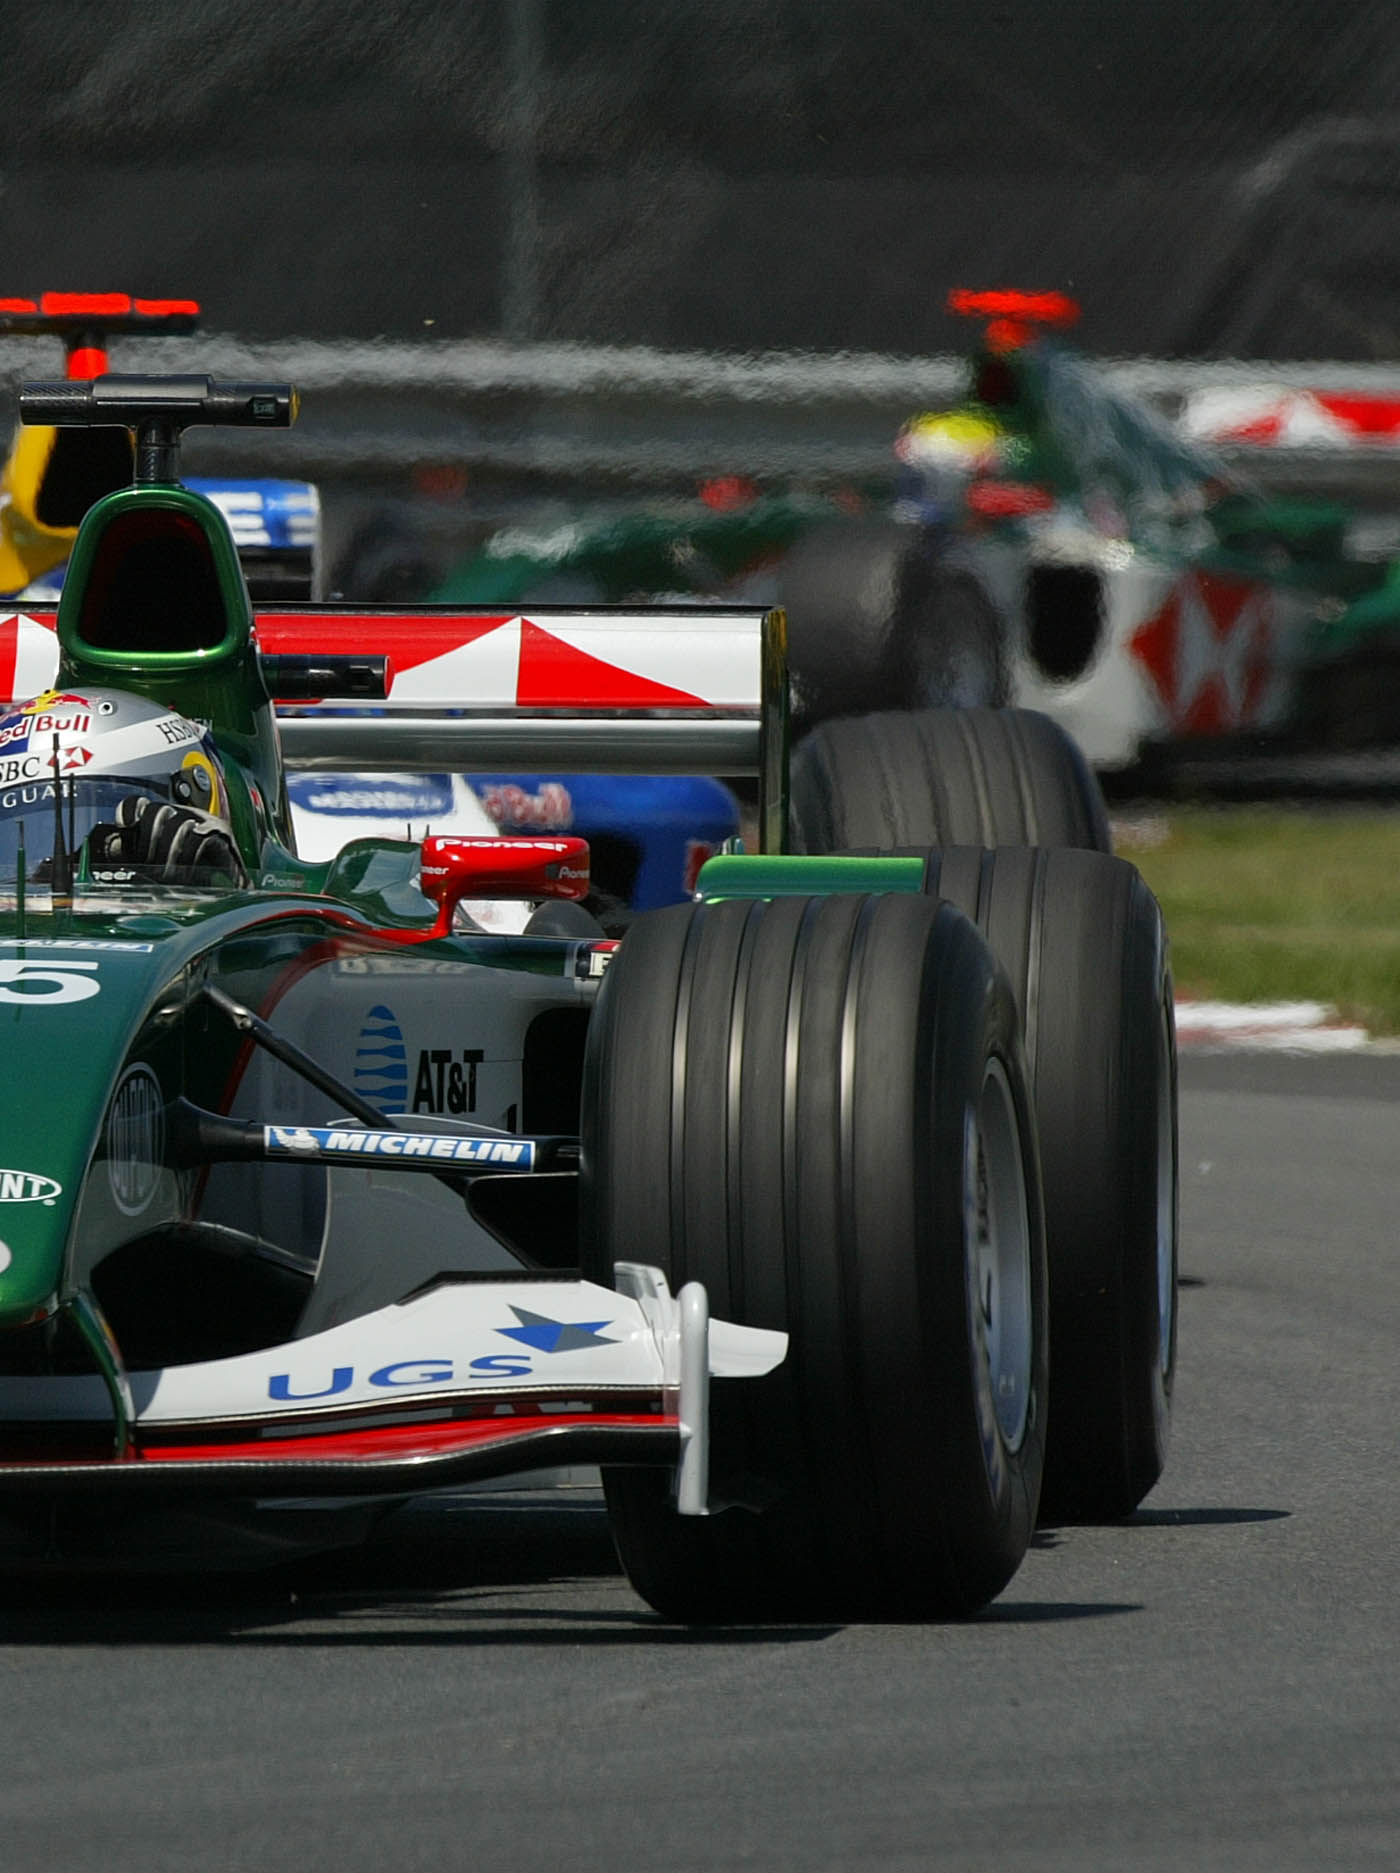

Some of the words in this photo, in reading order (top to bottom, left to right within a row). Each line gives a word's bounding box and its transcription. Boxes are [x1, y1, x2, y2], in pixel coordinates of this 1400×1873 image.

[34, 713, 90, 733] Bull
[435, 838, 568, 852] Pioneer
[412, 1050, 484, 1114] AT&T
[325, 1131, 524, 1163] MICHELIN
[268, 1354, 534, 1401] UGS
